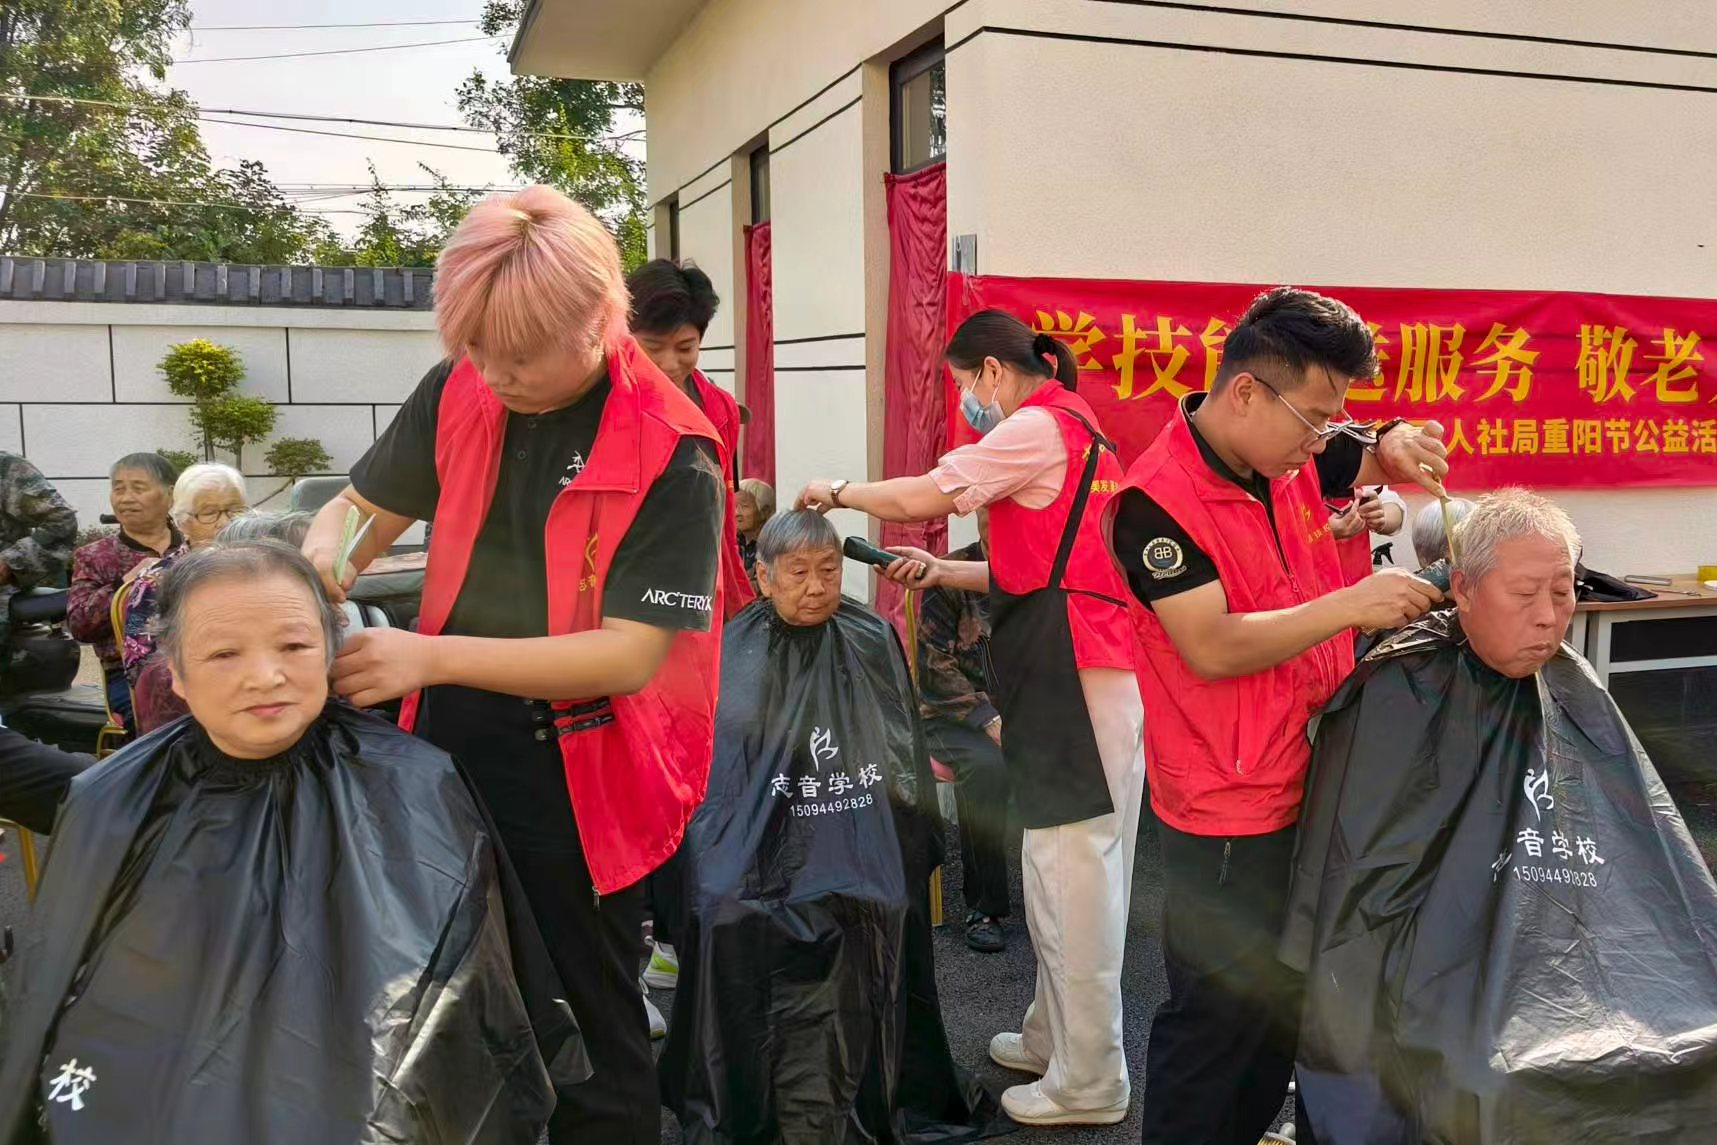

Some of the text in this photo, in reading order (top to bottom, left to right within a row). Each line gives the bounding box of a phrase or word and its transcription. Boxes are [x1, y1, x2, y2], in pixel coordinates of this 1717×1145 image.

[1574, 323, 1717, 403] 敬老
[1374, 417, 1717, 454] 人社局重阳节公益活
[790, 794, 873, 817] 15094492828
